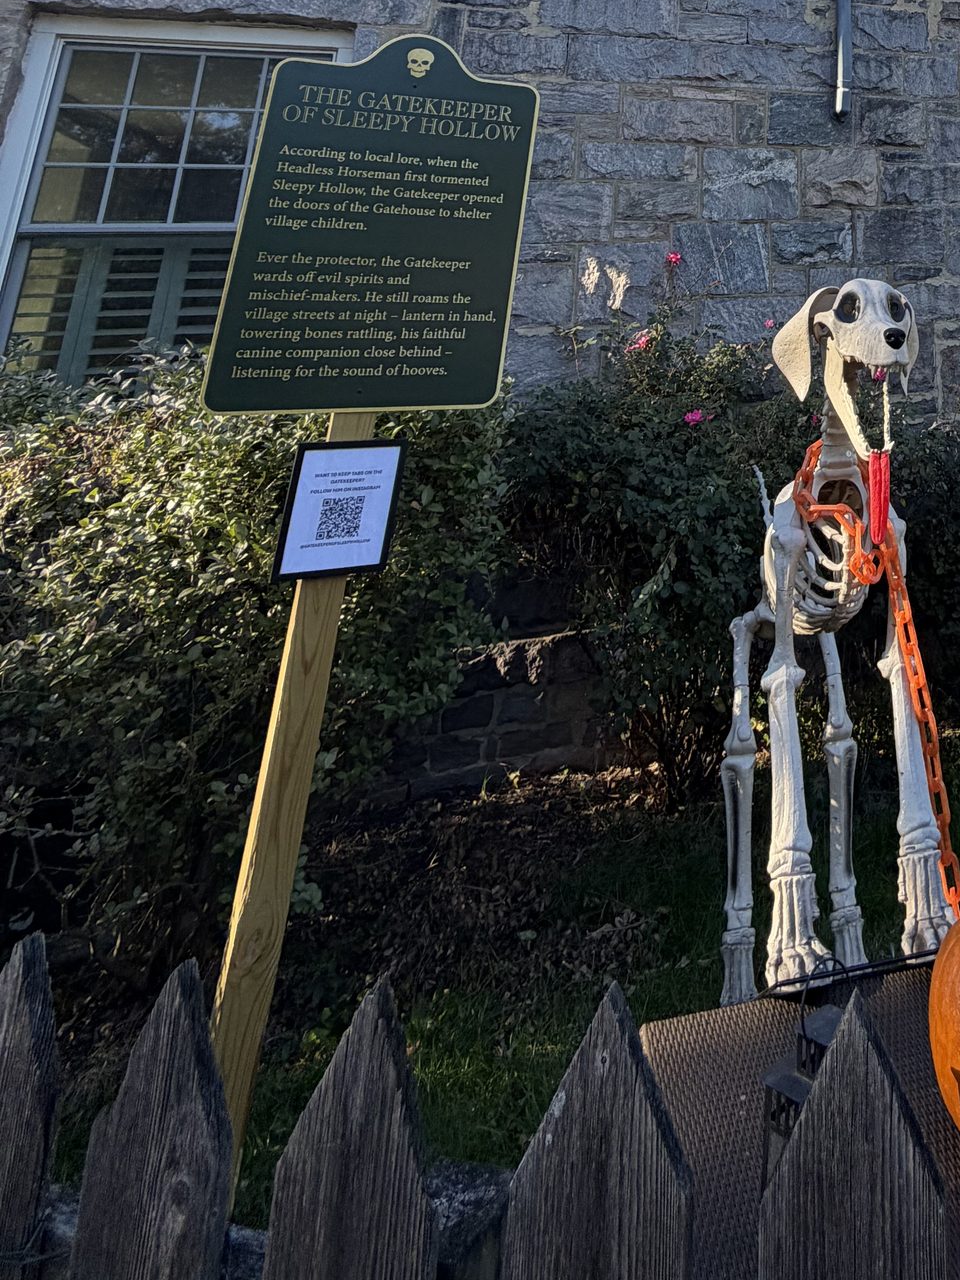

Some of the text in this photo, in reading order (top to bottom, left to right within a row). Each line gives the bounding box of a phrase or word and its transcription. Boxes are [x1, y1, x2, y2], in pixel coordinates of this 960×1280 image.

[299, 85, 512, 123] THE GATEKEEPER
[282, 104, 521, 142] OF SLEEPY HOLLOW
[279, 144, 479, 170] According to local lore, when the
[276, 161, 489, 187] Headless Horseman first tormented
[272, 179, 504, 206] Sleepy Hollow, the Gatekeeper opened
[268, 196, 492, 220] the doors of the Gatehouse to shelter
[264, 215, 368, 231] village children.
[256, 251, 472, 272] Ever the protector, the Gatekeeper
[253, 270, 411, 287] wards off evil spirits and
[248, 289, 472, 305] mischief-makers. He still roams the
[244, 307, 289, 324] village
[291, 309, 335, 321] streets
[338, 310, 351, 321] at
[353, 308, 387, 324] night
[401, 309, 445, 322] lantern
[448, 310, 460, 322] in
[463, 309, 498, 324] hand,
[240, 326, 466, 343] towering bones rattling, his faithful
[235, 346, 283, 359] canine
[285, 346, 360, 362] companion
[364, 345, 396, 358] close
[399, 344, 442, 358] behind
[231, 362, 448, 381] listening for the sound of hooves.
